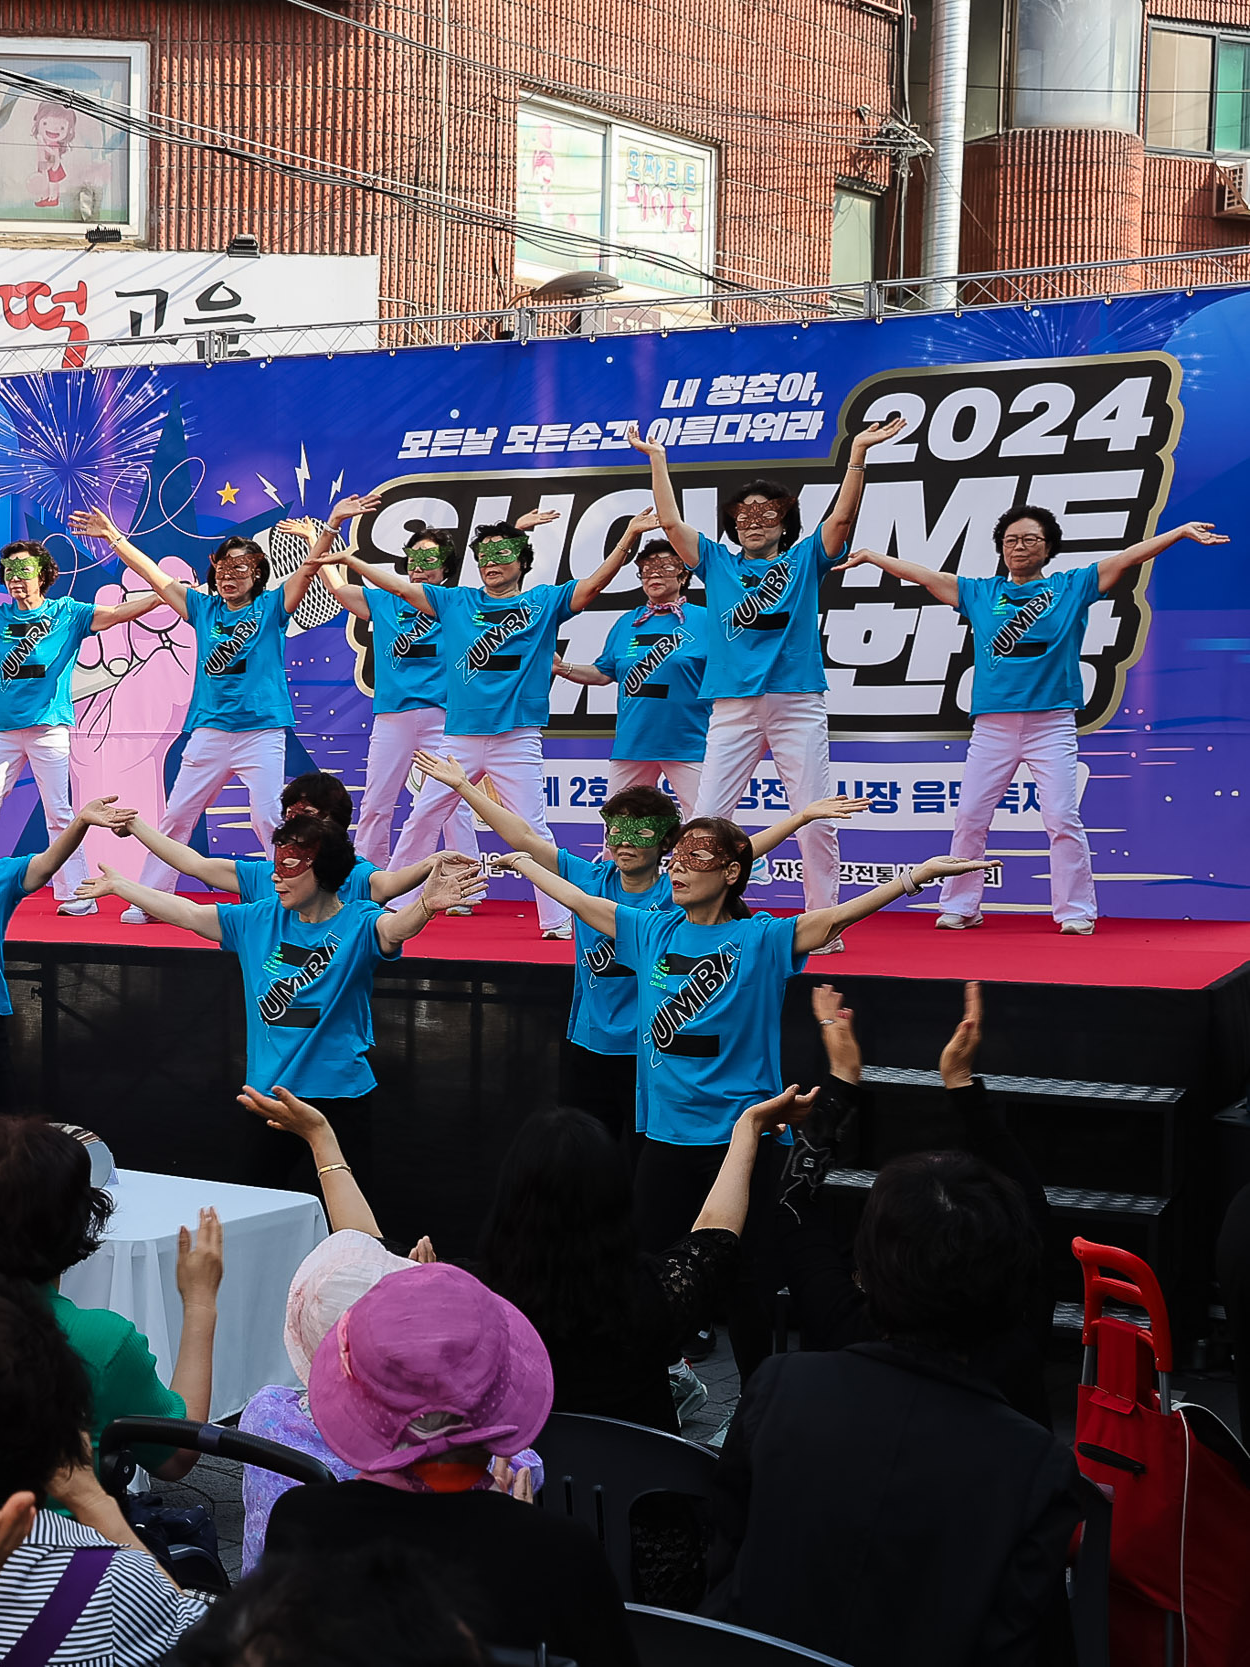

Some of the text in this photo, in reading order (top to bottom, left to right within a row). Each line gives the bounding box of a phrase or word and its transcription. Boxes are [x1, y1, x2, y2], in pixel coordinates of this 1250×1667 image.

[661, 372, 823, 409] 내 청춘아,
[862, 376, 1153, 465] 2024
[397, 410, 825, 460] 모든날 모든순간 아름다워라
[721, 552, 796, 641] ZUMBA
[202, 611, 262, 677] UMBA
[455, 598, 542, 684] ZUMBA
